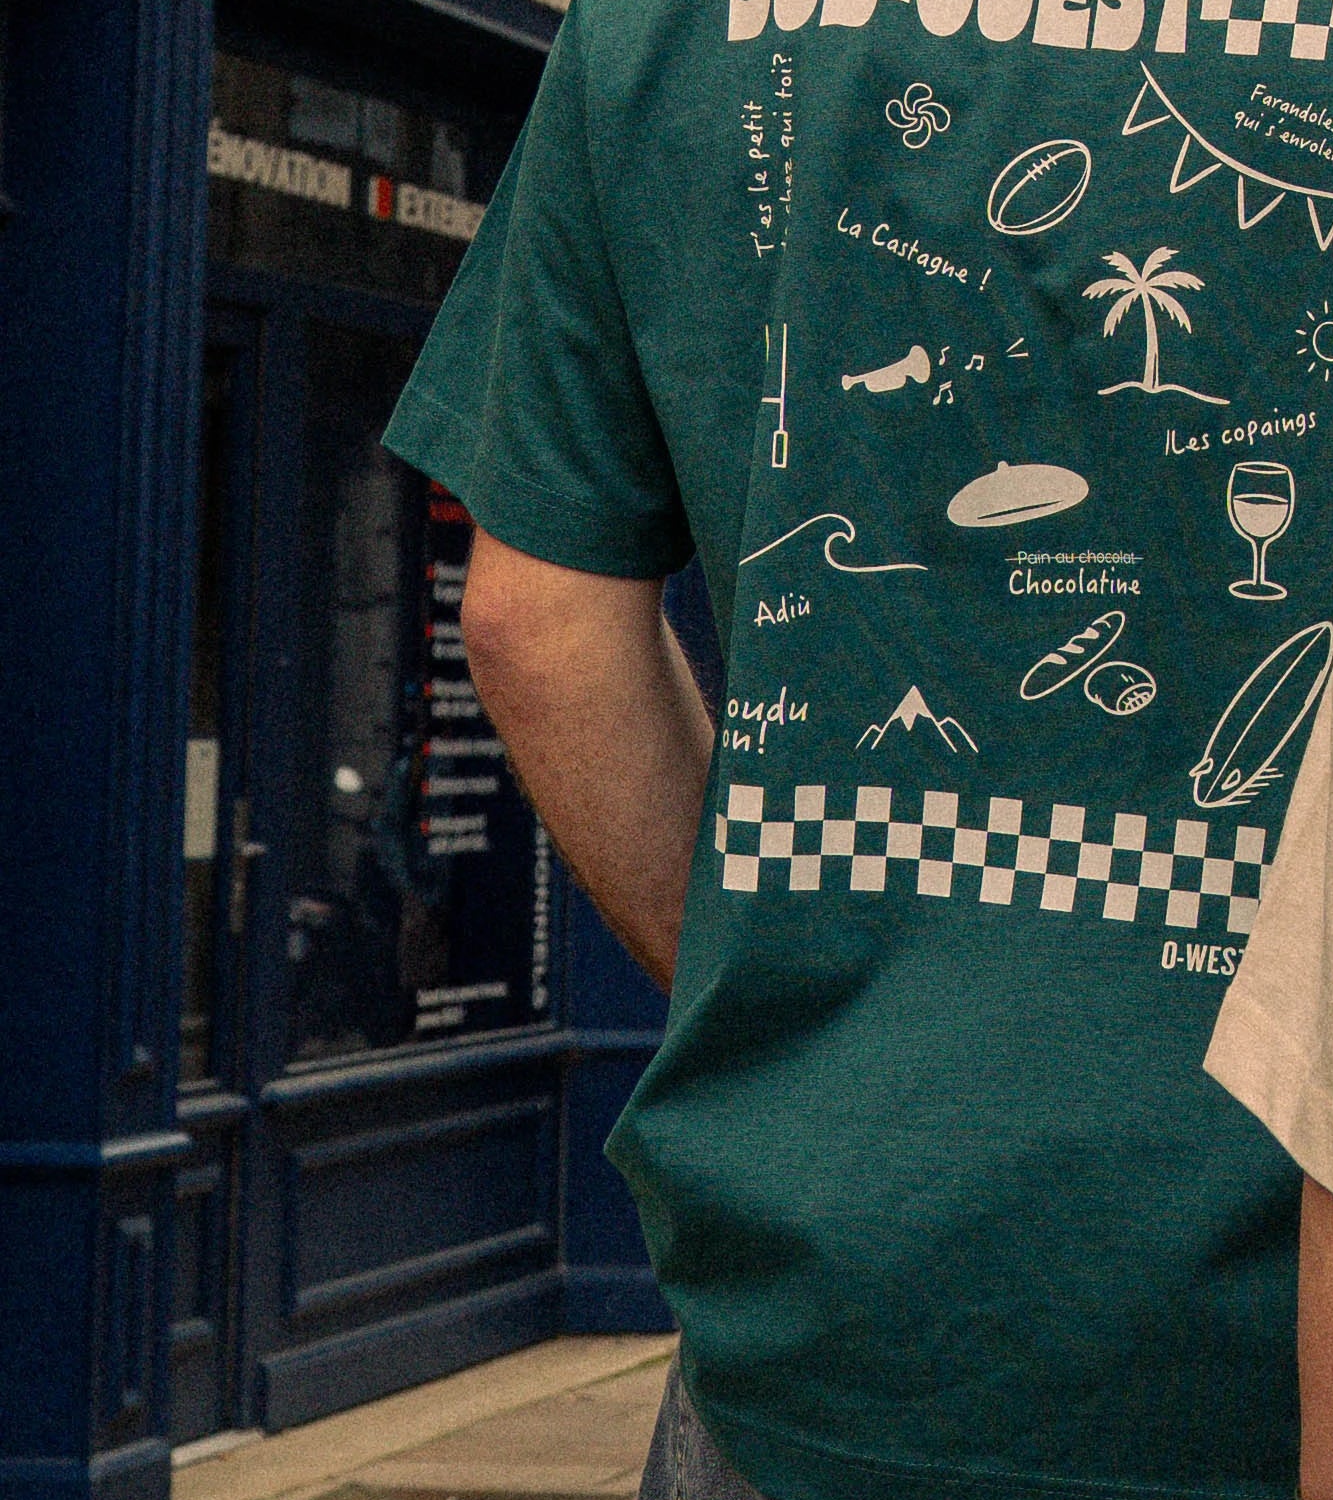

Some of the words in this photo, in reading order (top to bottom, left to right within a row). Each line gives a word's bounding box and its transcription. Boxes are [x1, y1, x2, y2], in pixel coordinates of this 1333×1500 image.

[771, 53, 793, 98] toi?
[740, 101, 770, 160] petit
[772, 111, 795, 148] qui
[1234, 111, 1264, 132] qui
[747, 170, 769, 192] le
[750, 203, 775, 259] T'es
[837, 207, 862, 239] La
[872, 223, 969, 284] Castagne
[1221, 407, 1316, 446] copaings
[1017, 550, 1050, 565] Pain
[1055, 552, 1075, 564] au
[1079, 549, 1136, 564] chocolat
[1009, 566, 1141, 595] Chocolatine
[727, 685, 809, 725] oudu
[722, 720, 767, 754] on!
[1160, 940, 1246, 977] O-WES
